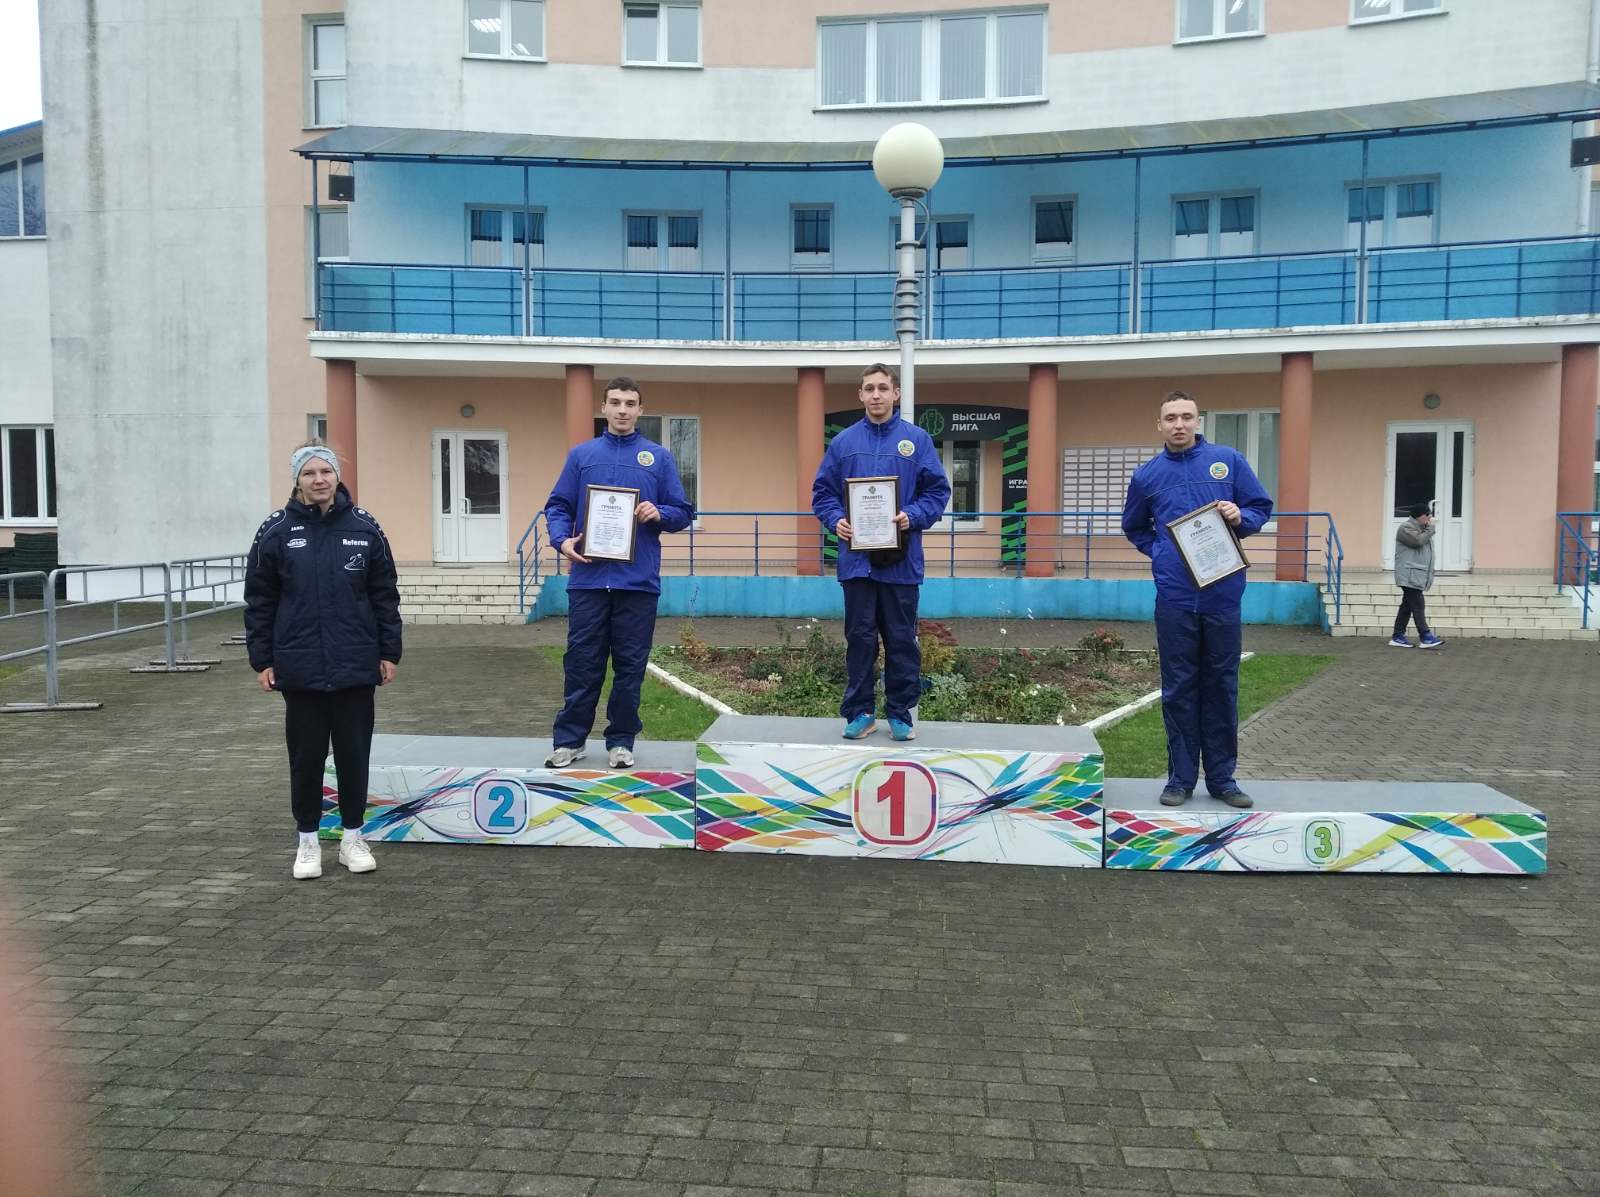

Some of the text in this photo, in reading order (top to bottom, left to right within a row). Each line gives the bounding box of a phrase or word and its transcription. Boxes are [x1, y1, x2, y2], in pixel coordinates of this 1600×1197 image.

[951, 423, 979, 431] ЛИГА
[952, 413, 1001, 421] ВЫСШАЯ
[488, 786, 514, 827] 2
[877, 771, 905, 836] 1
[1313, 826, 1332, 858] 3
